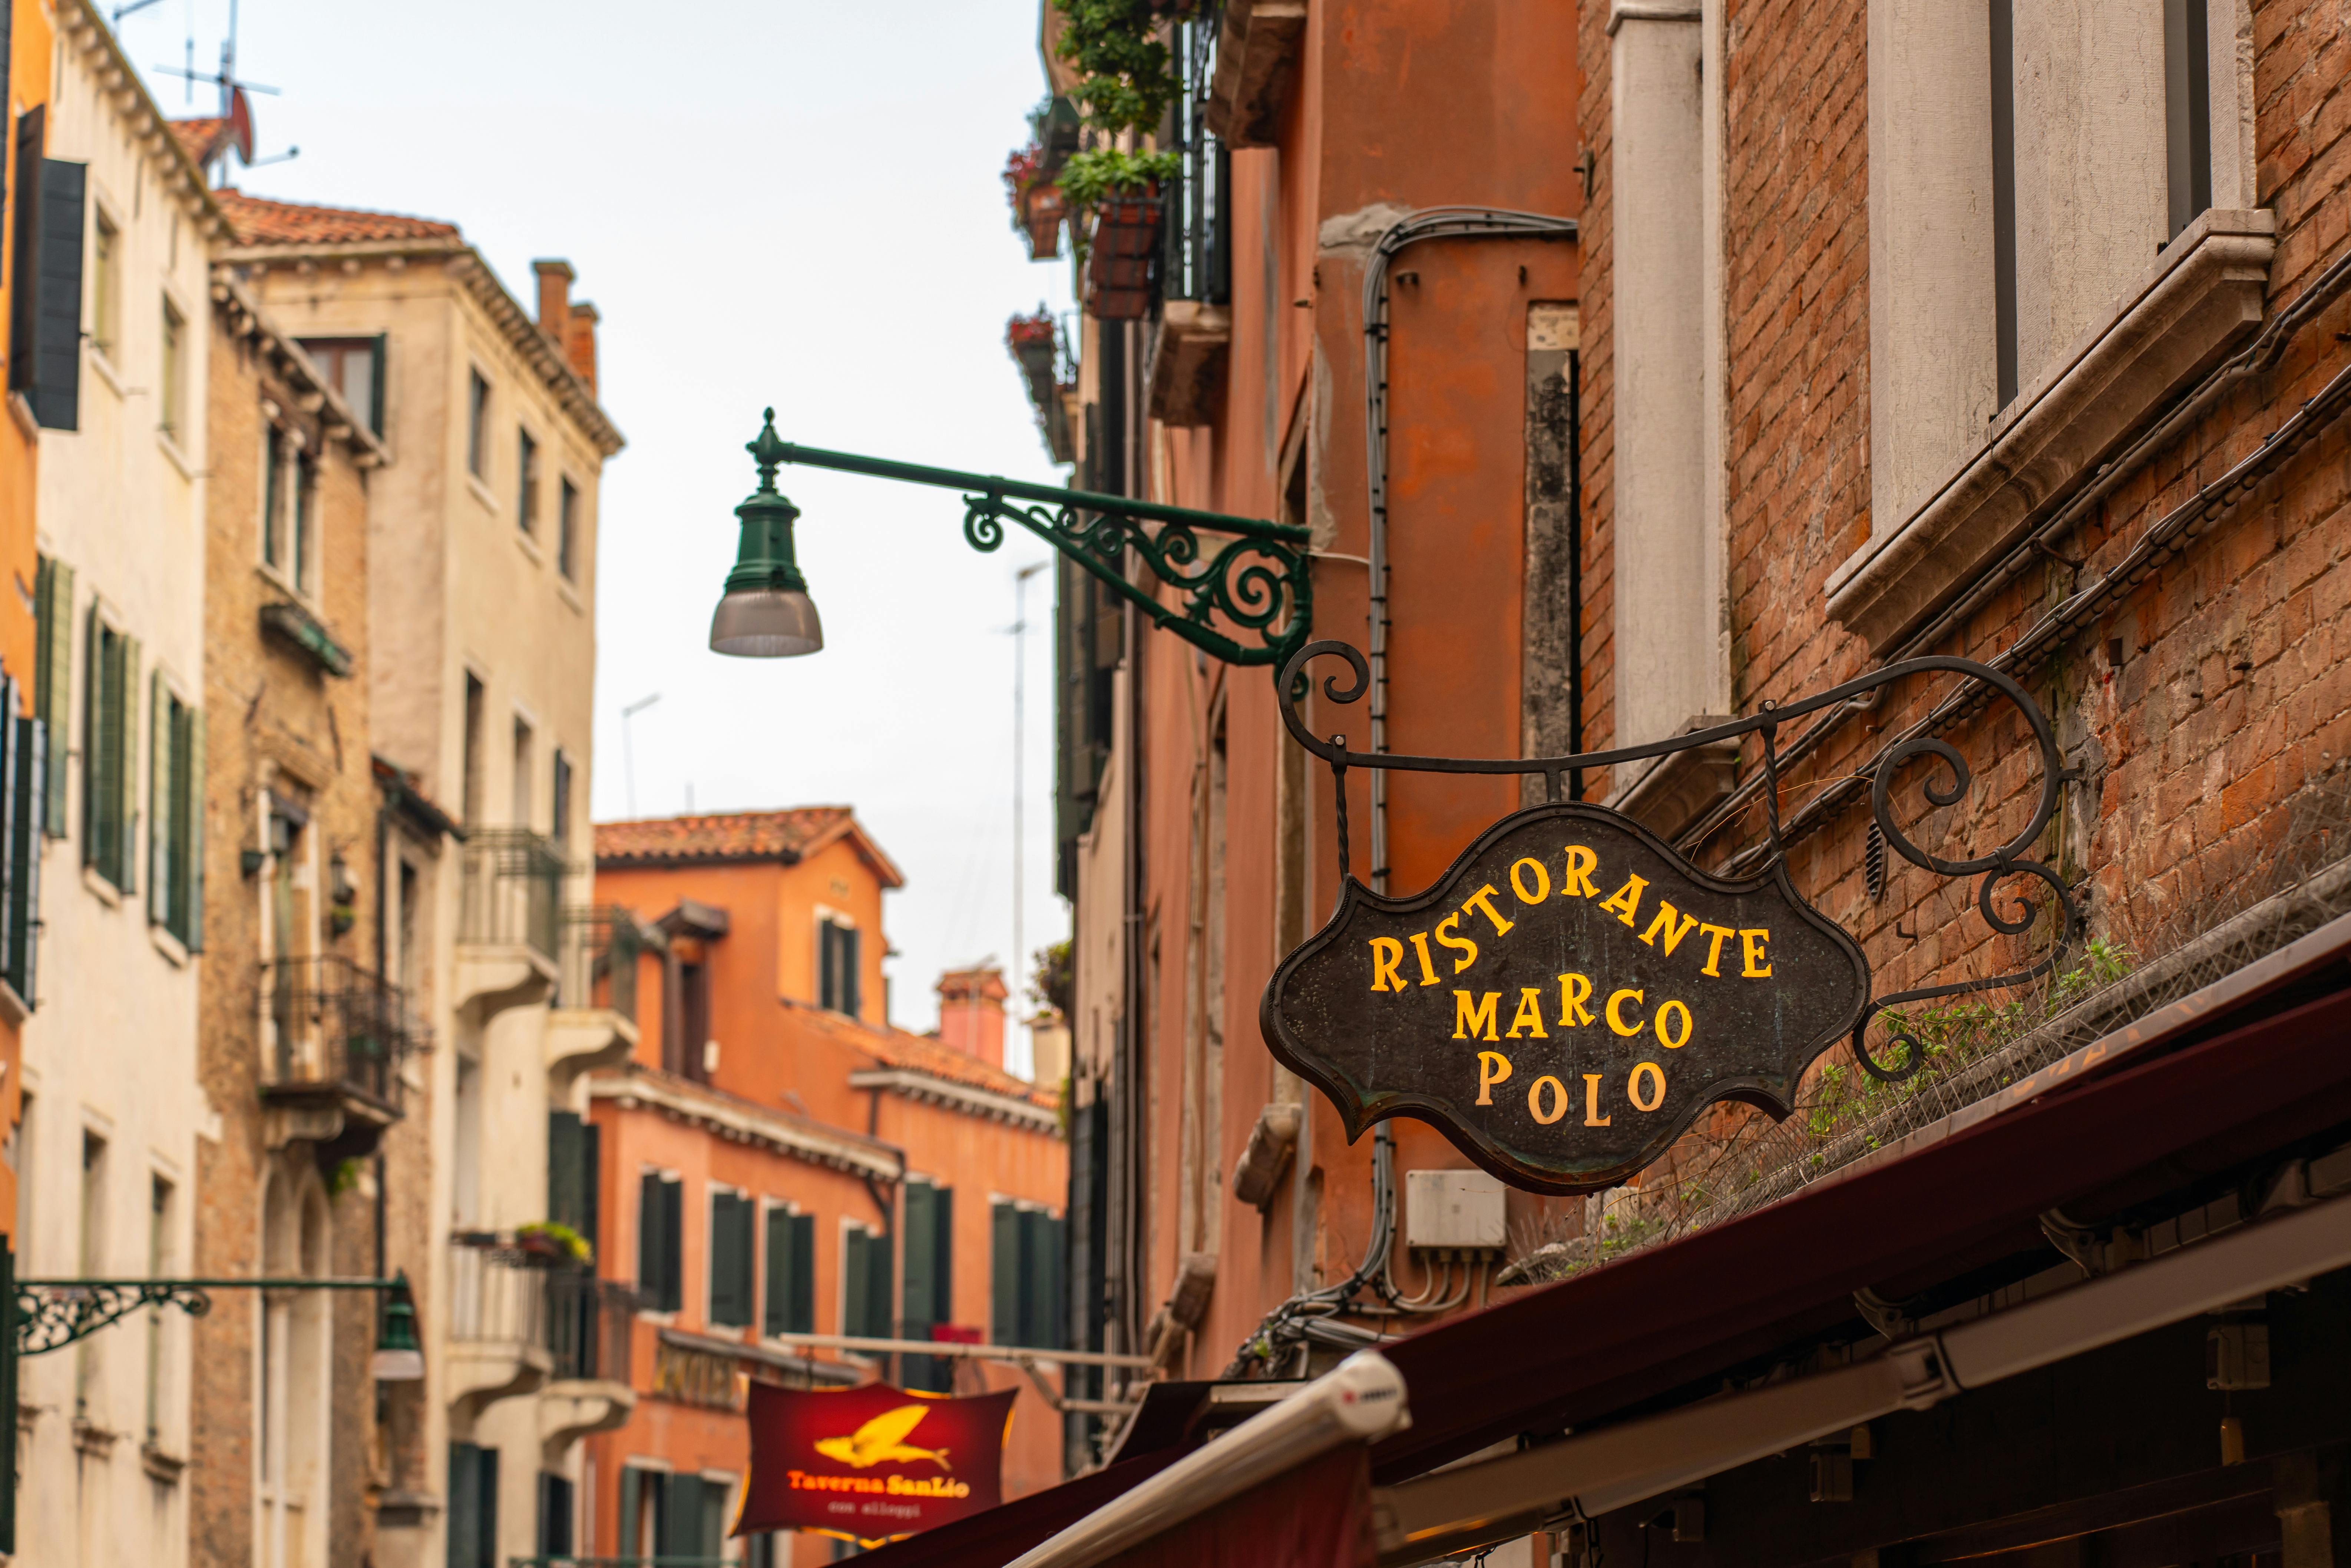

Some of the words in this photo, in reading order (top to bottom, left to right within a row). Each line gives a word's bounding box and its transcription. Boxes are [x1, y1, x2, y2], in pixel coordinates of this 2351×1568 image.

[1368, 845, 1772, 993] RISTORANTE
[1452, 973, 1693, 1049] MARCO
[1475, 1051, 1666, 1127] POLO
[787, 1470, 885, 1493] Taverna
[828, 1501, 856, 1514] con
